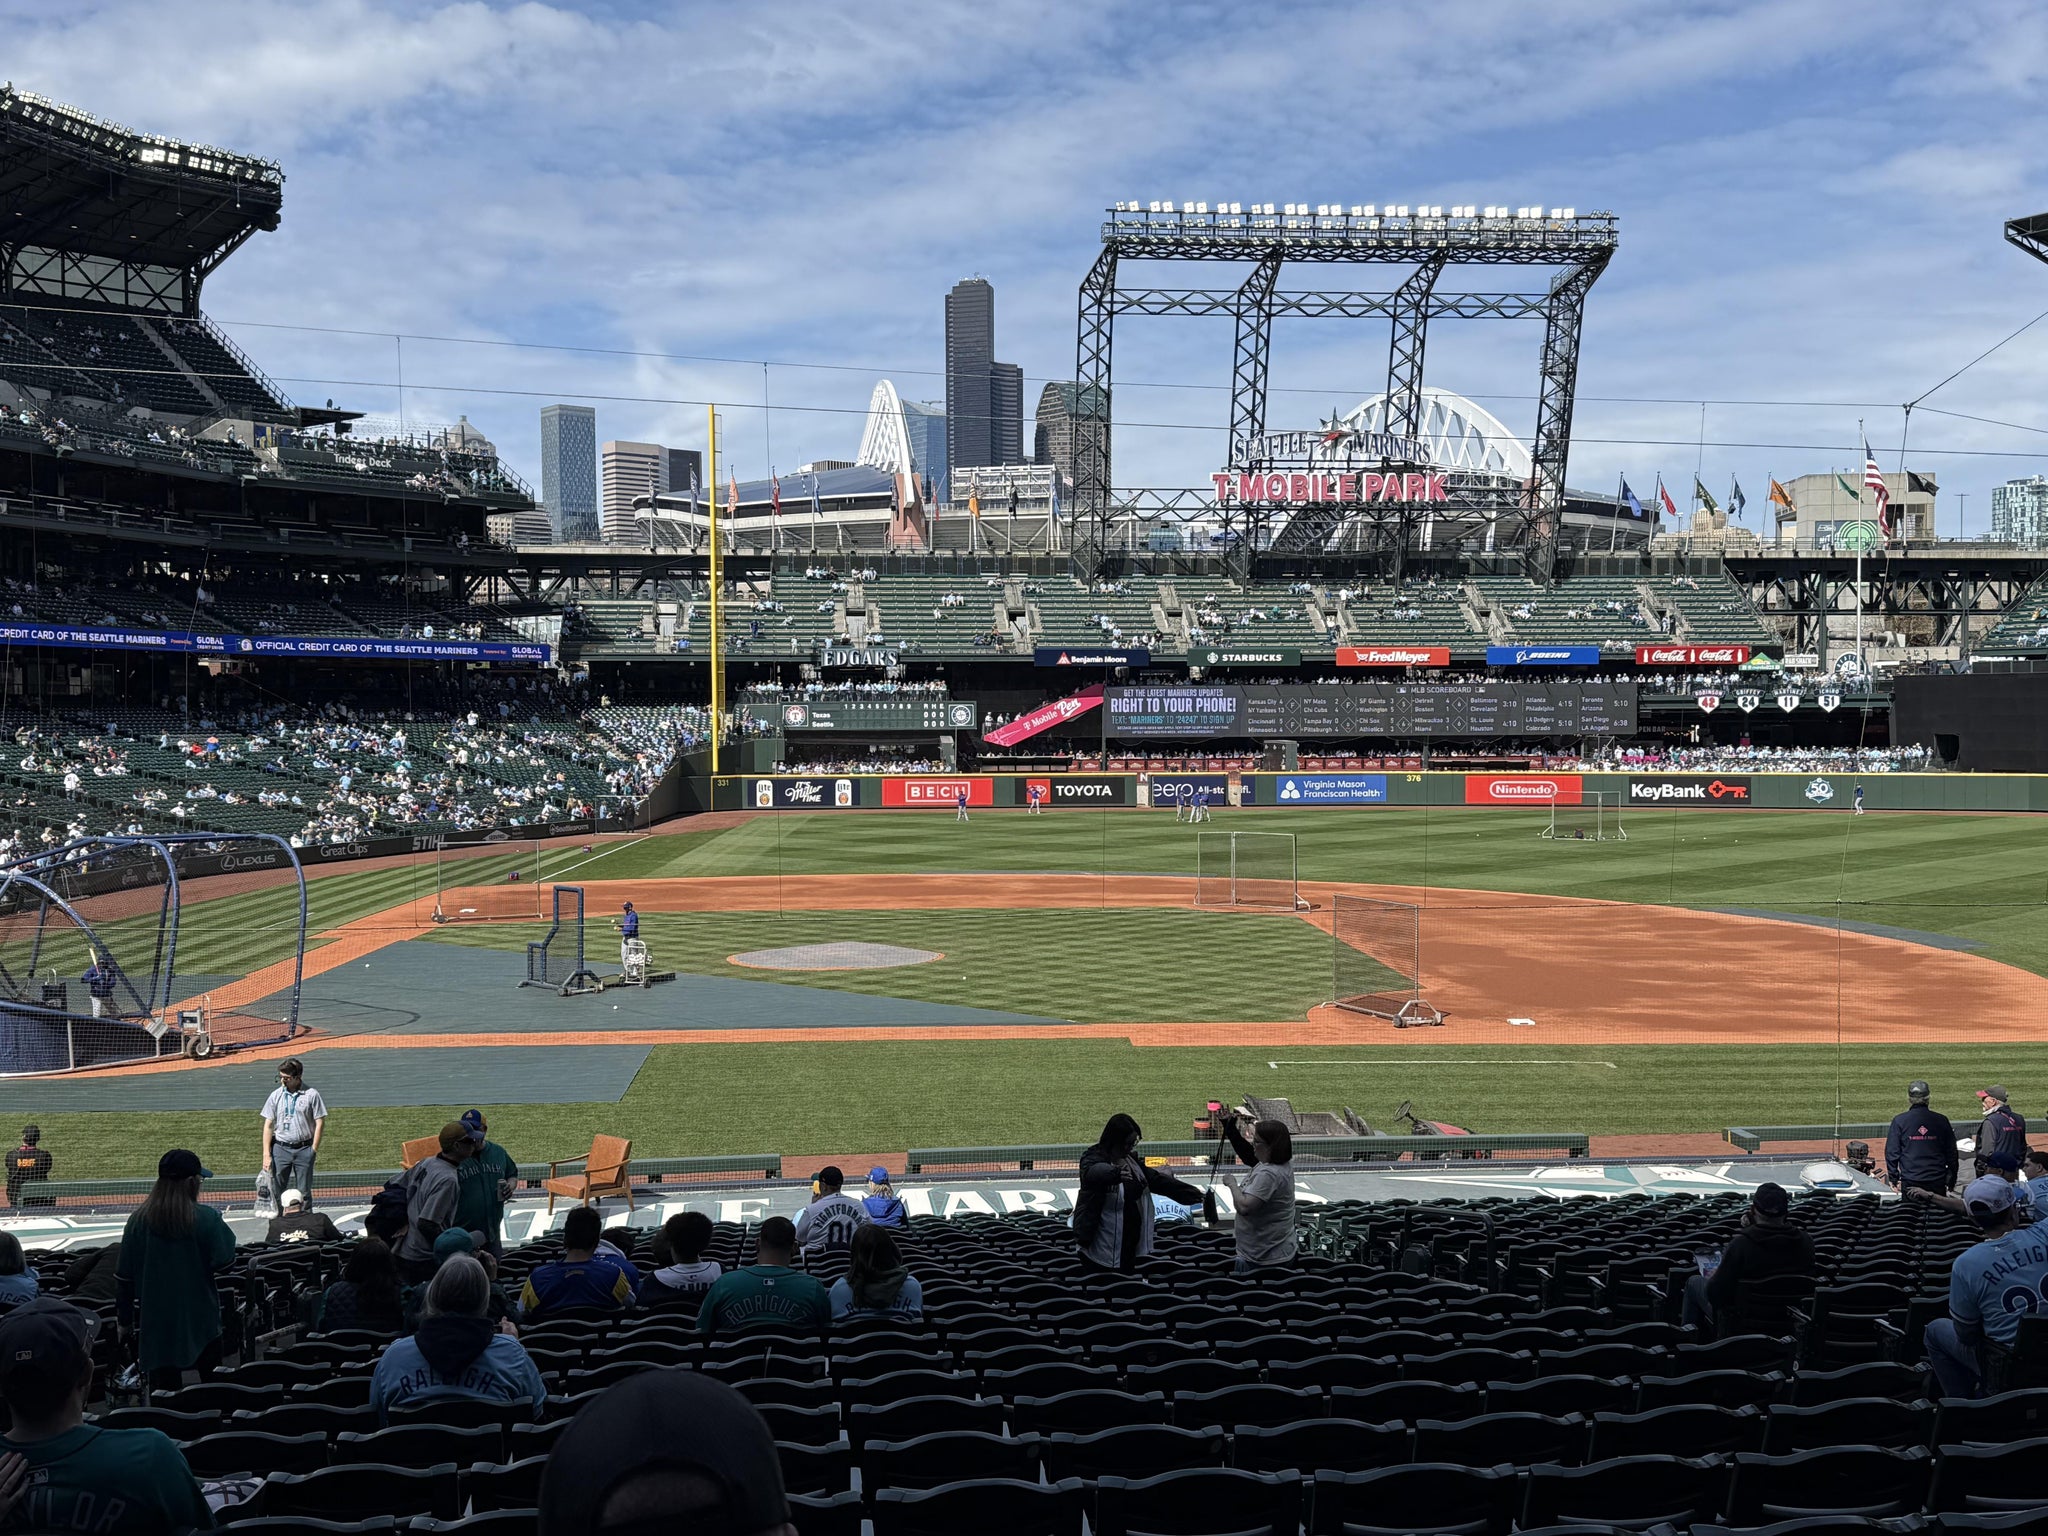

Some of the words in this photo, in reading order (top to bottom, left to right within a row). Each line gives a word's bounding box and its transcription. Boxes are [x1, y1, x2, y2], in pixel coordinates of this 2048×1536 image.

[1234, 432, 1309, 463] SEATTLE
[1352, 432, 1431, 463] MARINERS
[1210, 472, 1357, 502] T-MOBILE
[1363, 472, 1449, 502] PARK
[31, 630, 54, 640] CARD
[56, 631, 69, 640] OF
[70, 632, 87, 641] THE
[89, 633, 124, 643] SEATTLE
[126, 634, 166, 645] MARINERS
[196, 636, 224, 645] GLOBAL
[255, 641, 296, 650] OFFICIAL
[298, 642, 331, 651] CREDIT
[332, 643, 357, 652] CARD
[360, 644, 373, 653] OF
[374, 645, 392, 653] THE
[394, 645, 433, 654] SEATTLE
[434, 646, 478, 655] MARINERS
[511, 646, 542, 654] GLOBAL
[1071, 655, 1103, 664] Benjamin
[1104, 655, 1127, 663] Moore
[1221, 654, 1282, 662] STARBUCKS
[1123, 689, 1134, 697] GET
[1135, 689, 1146, 697] THE
[1147, 689, 1166, 697] LATEST
[1168, 689, 1197, 697] MARINERS
[1199, 689, 1224, 697] UPDATES
[1111, 698, 1144, 713] RIGHT
[1146, 698, 1160, 713] TO
[1163, 698, 1193, 713] YOUR
[1196, 698, 1236, 713] PHONE!
[1701, 696, 1716, 708] 42
[1741, 696, 1755, 708] 24
[1783, 696, 1793, 707] 11
[1823, 696, 1835, 707] 51
[1031, 710, 1058, 727] Mobile
[1112, 715, 1127, 724] TEXT:
[1166, 715, 1174, 724] TO
[1200, 715, 1208, 724] TO
[1209, 715, 1224, 724] SIGN
[1226, 715, 1235, 724] UP
[717, 779, 729, 787] 331
[1406, 774, 1421, 782] 376
[758, 783, 771, 793] Lite
[795, 781, 811, 789] IT'S
[837, 783, 850, 792] Lite
[1153, 783, 1194, 797] eero
[1303, 780, 1335, 791] Virginia
[1337, 780, 1366, 788] Mason
[1495, 785, 1553, 795] Nintendo
[1811, 783, 1829, 793] 50
[785, 785, 823, 802] Miller
[1055, 785, 1112, 797] TOYOTA
[1304, 789, 1349, 798] Franciscan
[1350, 789, 1380, 798] Health
[1631, 784, 1706, 800] KeyBank
[802, 794, 822, 803] TIME
[412, 834, 448, 851] STIHL
[320, 845, 346, 858] Great
[347, 843, 368, 856] Clips
[236, 854, 276, 866] LEXUS
[1154, 1203, 1185, 1217] ALEIGH
